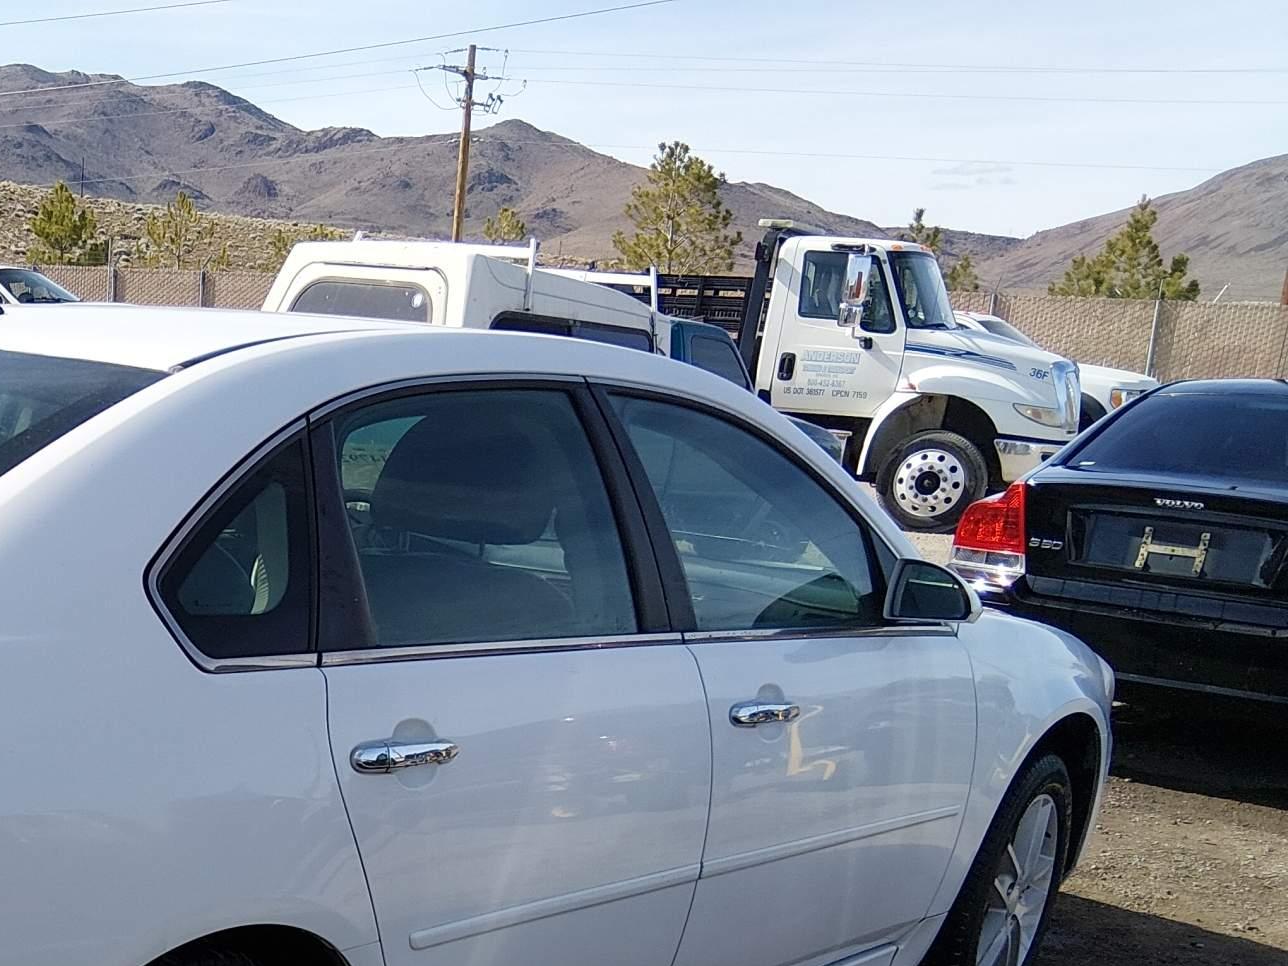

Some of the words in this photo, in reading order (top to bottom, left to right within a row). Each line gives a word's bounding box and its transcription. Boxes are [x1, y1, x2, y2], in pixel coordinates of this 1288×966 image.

[801, 349, 861, 364] ANDERSON
[1029, 368, 1049, 380] 36F
[793, 387, 804, 395] DOT
[1153, 498, 1205, 510] VOLVO
